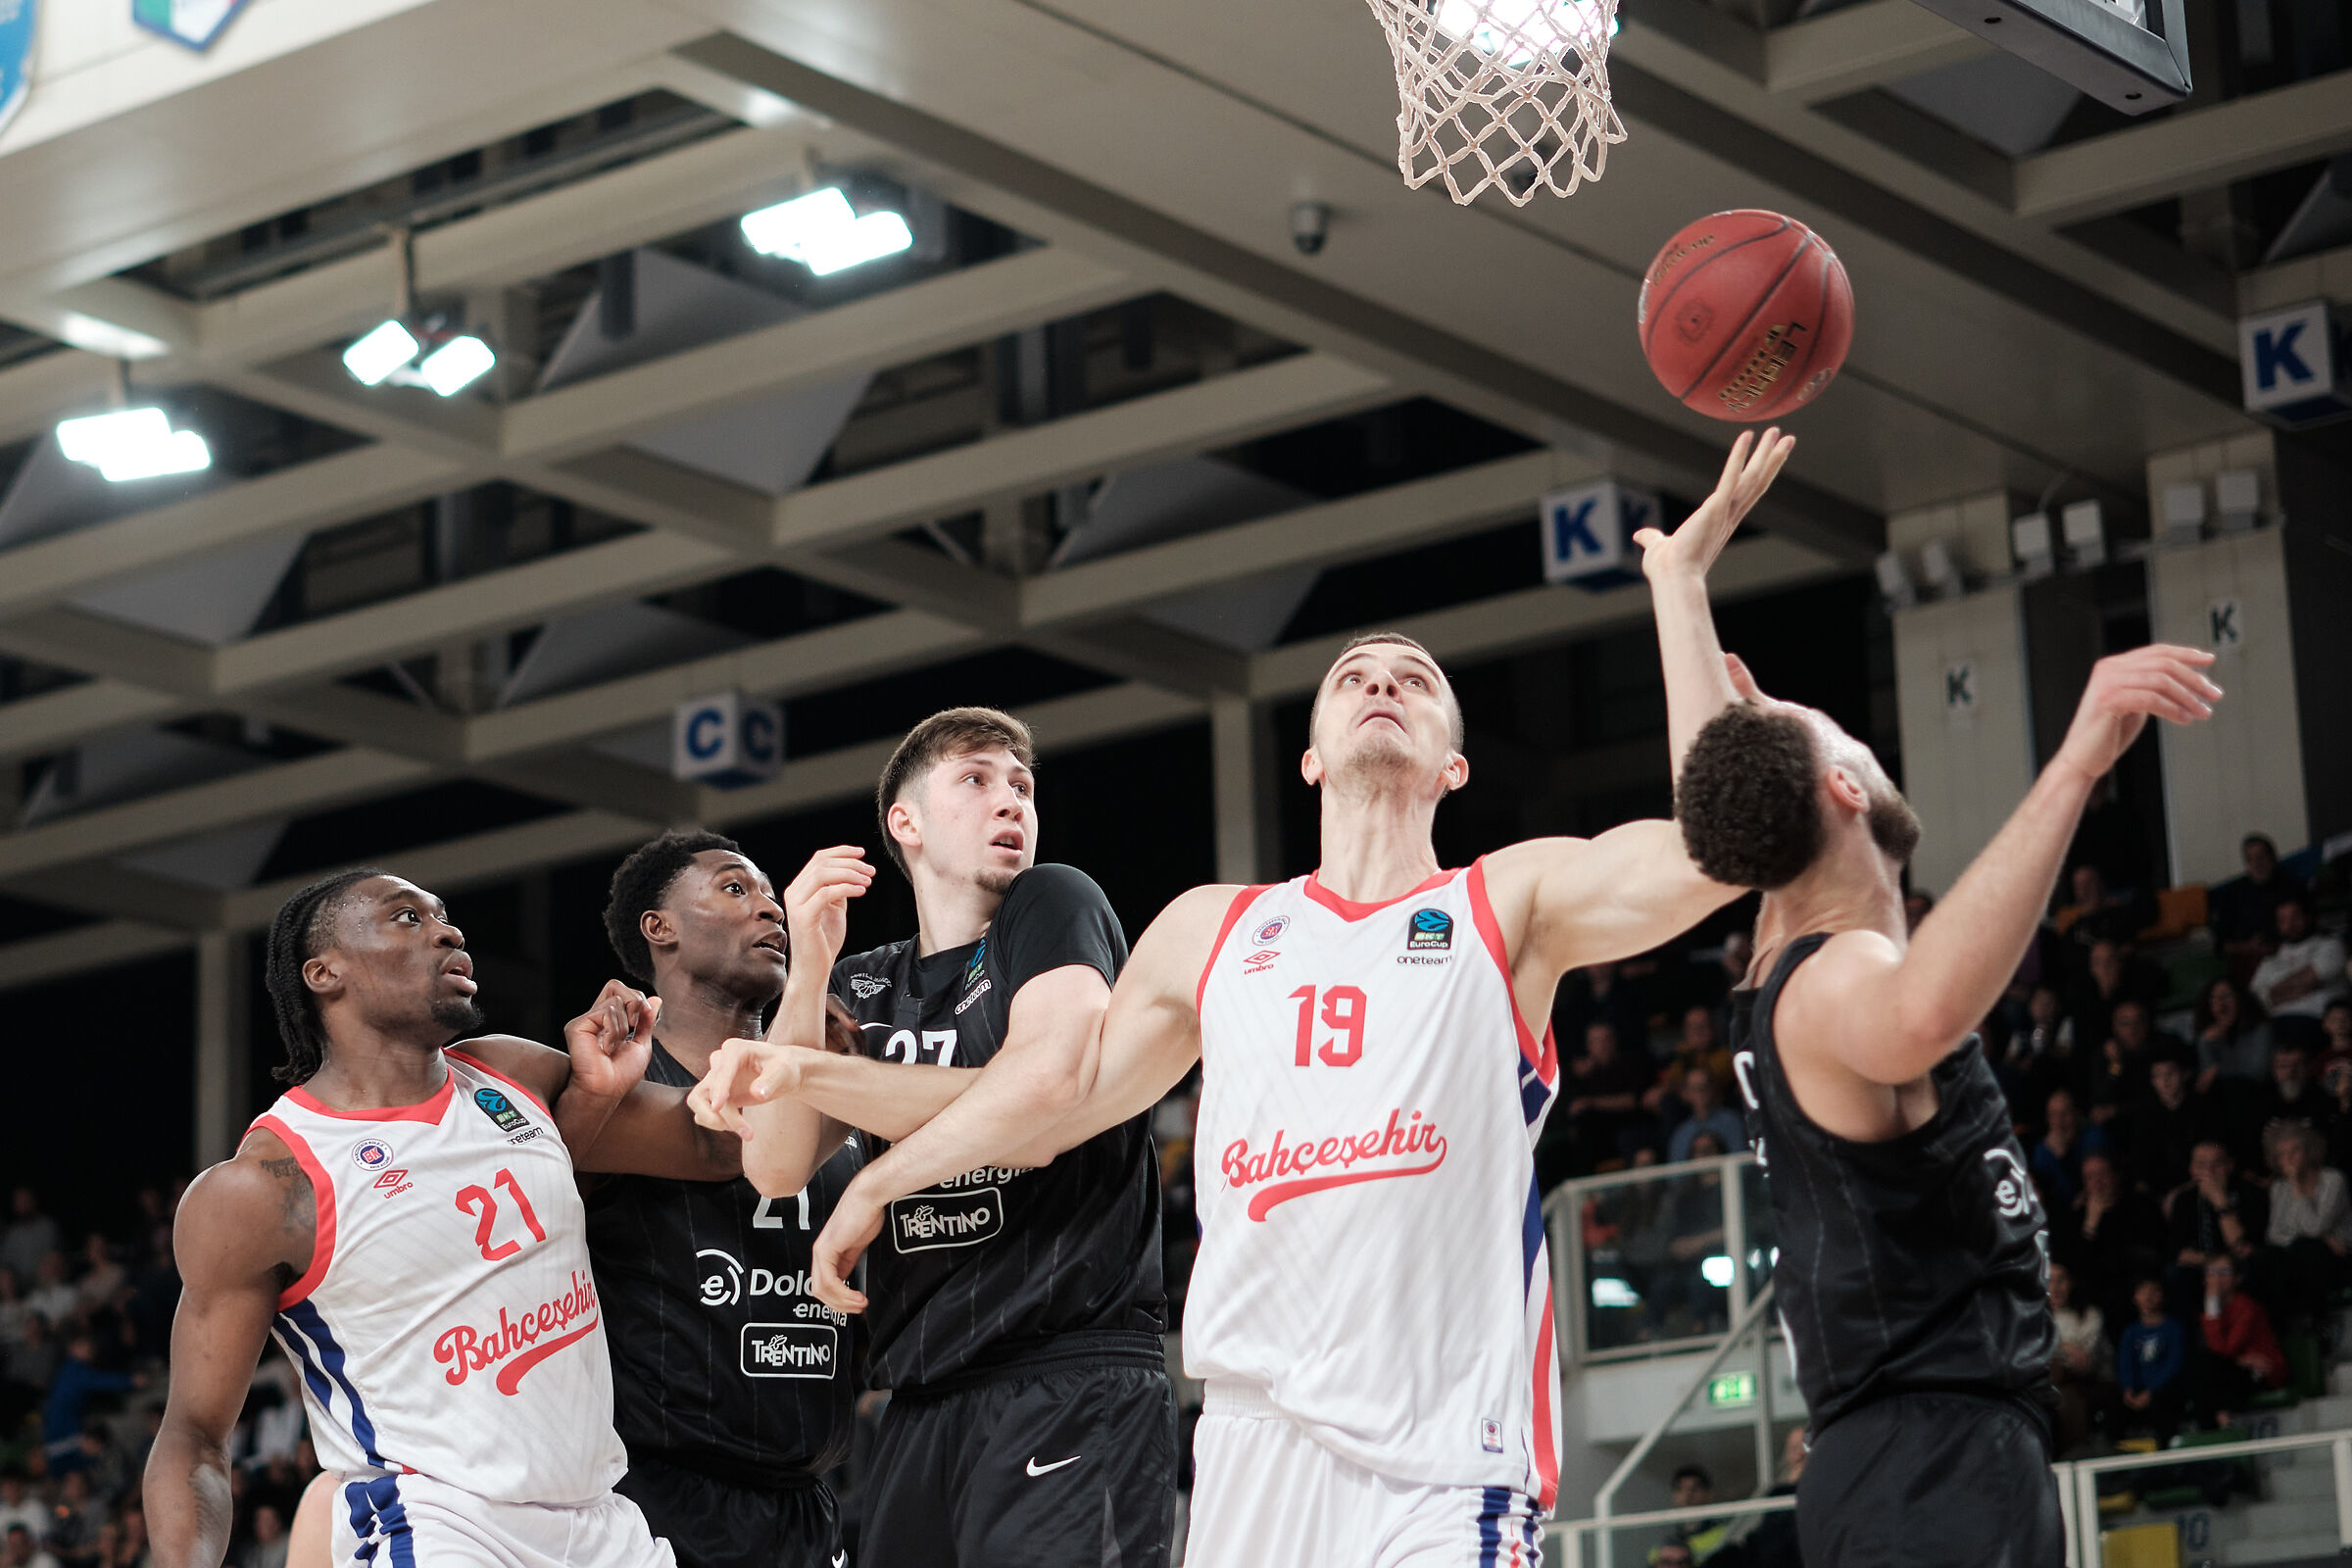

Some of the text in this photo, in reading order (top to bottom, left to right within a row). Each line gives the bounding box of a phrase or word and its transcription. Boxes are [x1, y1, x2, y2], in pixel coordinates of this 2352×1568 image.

[2253, 319, 2316, 391] K
[1554, 498, 1603, 563] K
[2211, 604, 2236, 643] K
[1946, 666, 1973, 705] K
[686, 708, 724, 760] C
[742, 710, 774, 764] C
[1287, 984, 1367, 1067] 19
[364, 1147, 382, 1162] BK
[1219, 1107, 1447, 1193] Bahçeşehir
[383, 1182, 414, 1199] umbro
[455, 1167, 547, 1261] 21
[900, 1206, 991, 1239] TRENTINO
[433, 1269, 599, 1387] Bahçeşehir
[751, 1340, 831, 1368] TRENTINO
